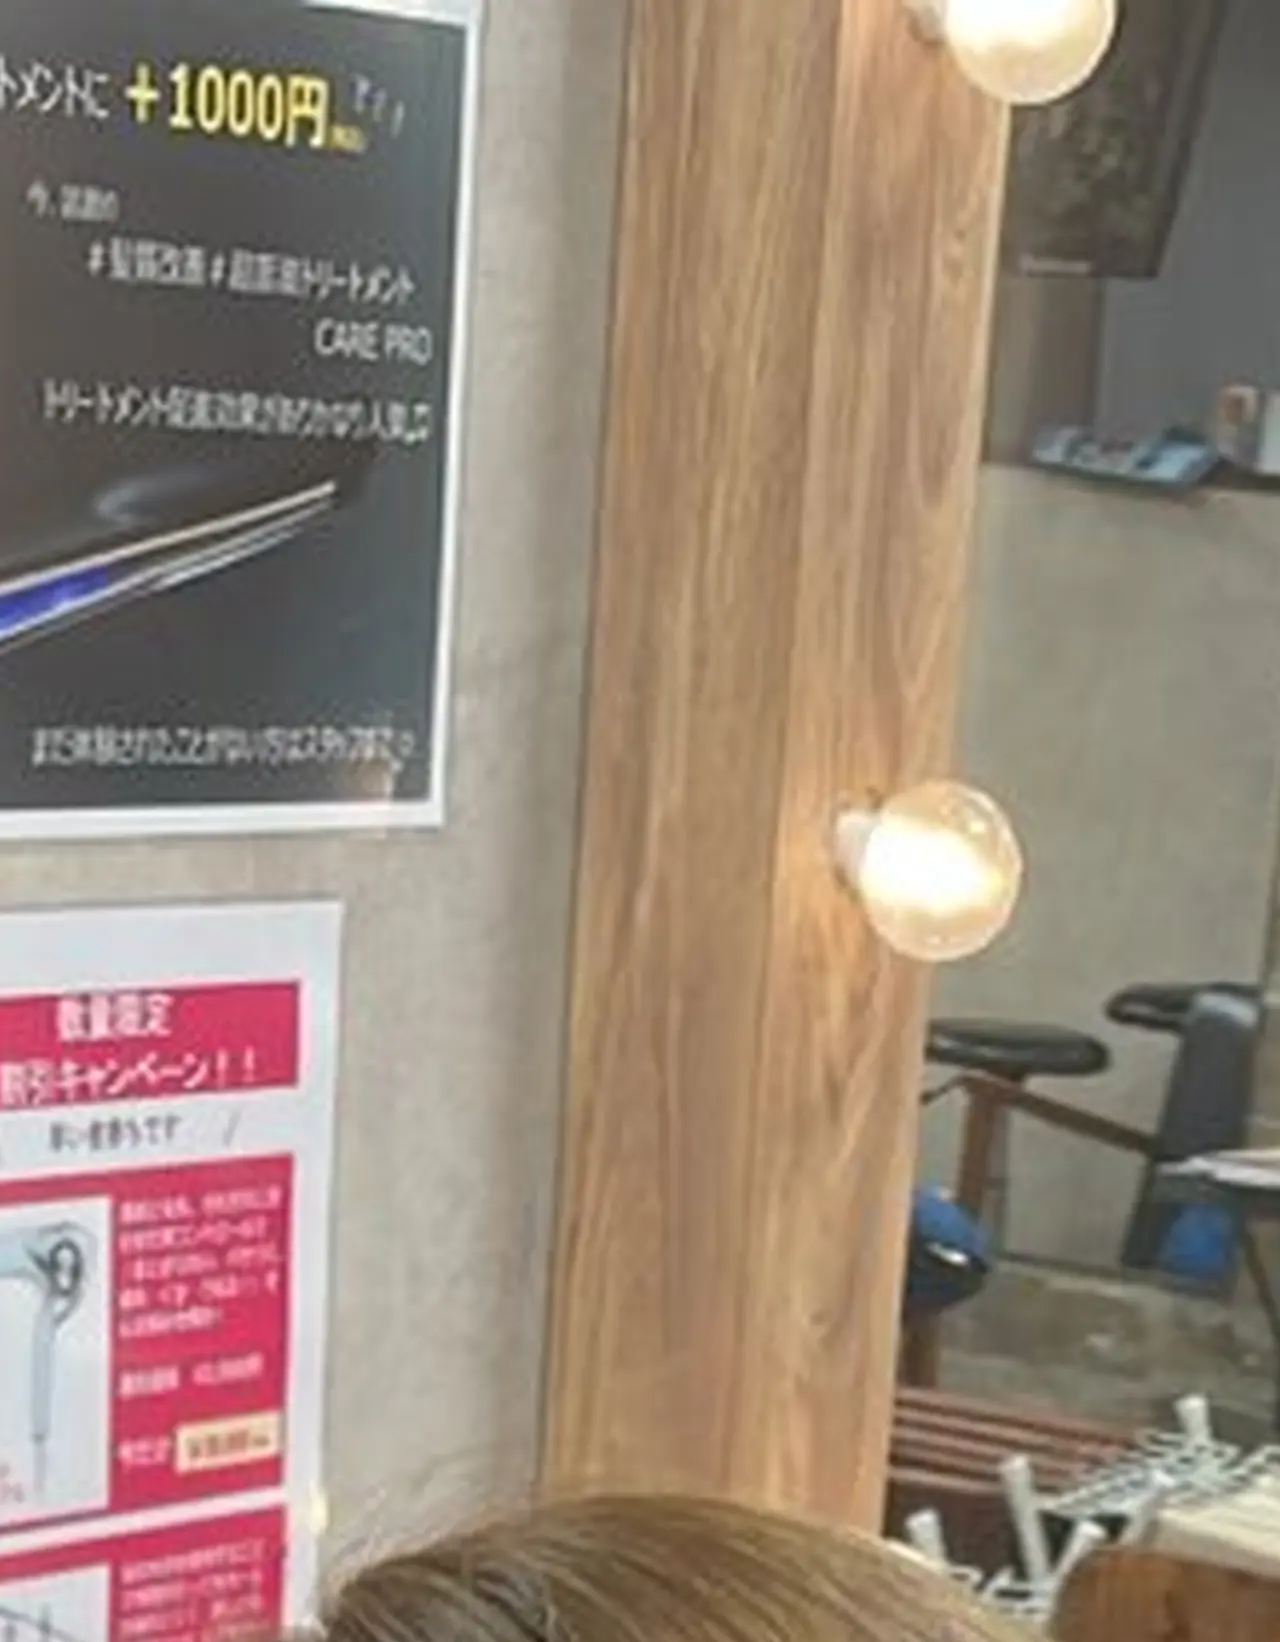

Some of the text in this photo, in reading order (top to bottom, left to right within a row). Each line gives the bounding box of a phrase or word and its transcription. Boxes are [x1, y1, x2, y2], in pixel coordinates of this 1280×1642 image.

[314, 316, 434, 366] CARE PRO
[55, 992, 174, 1042] 数量限定
